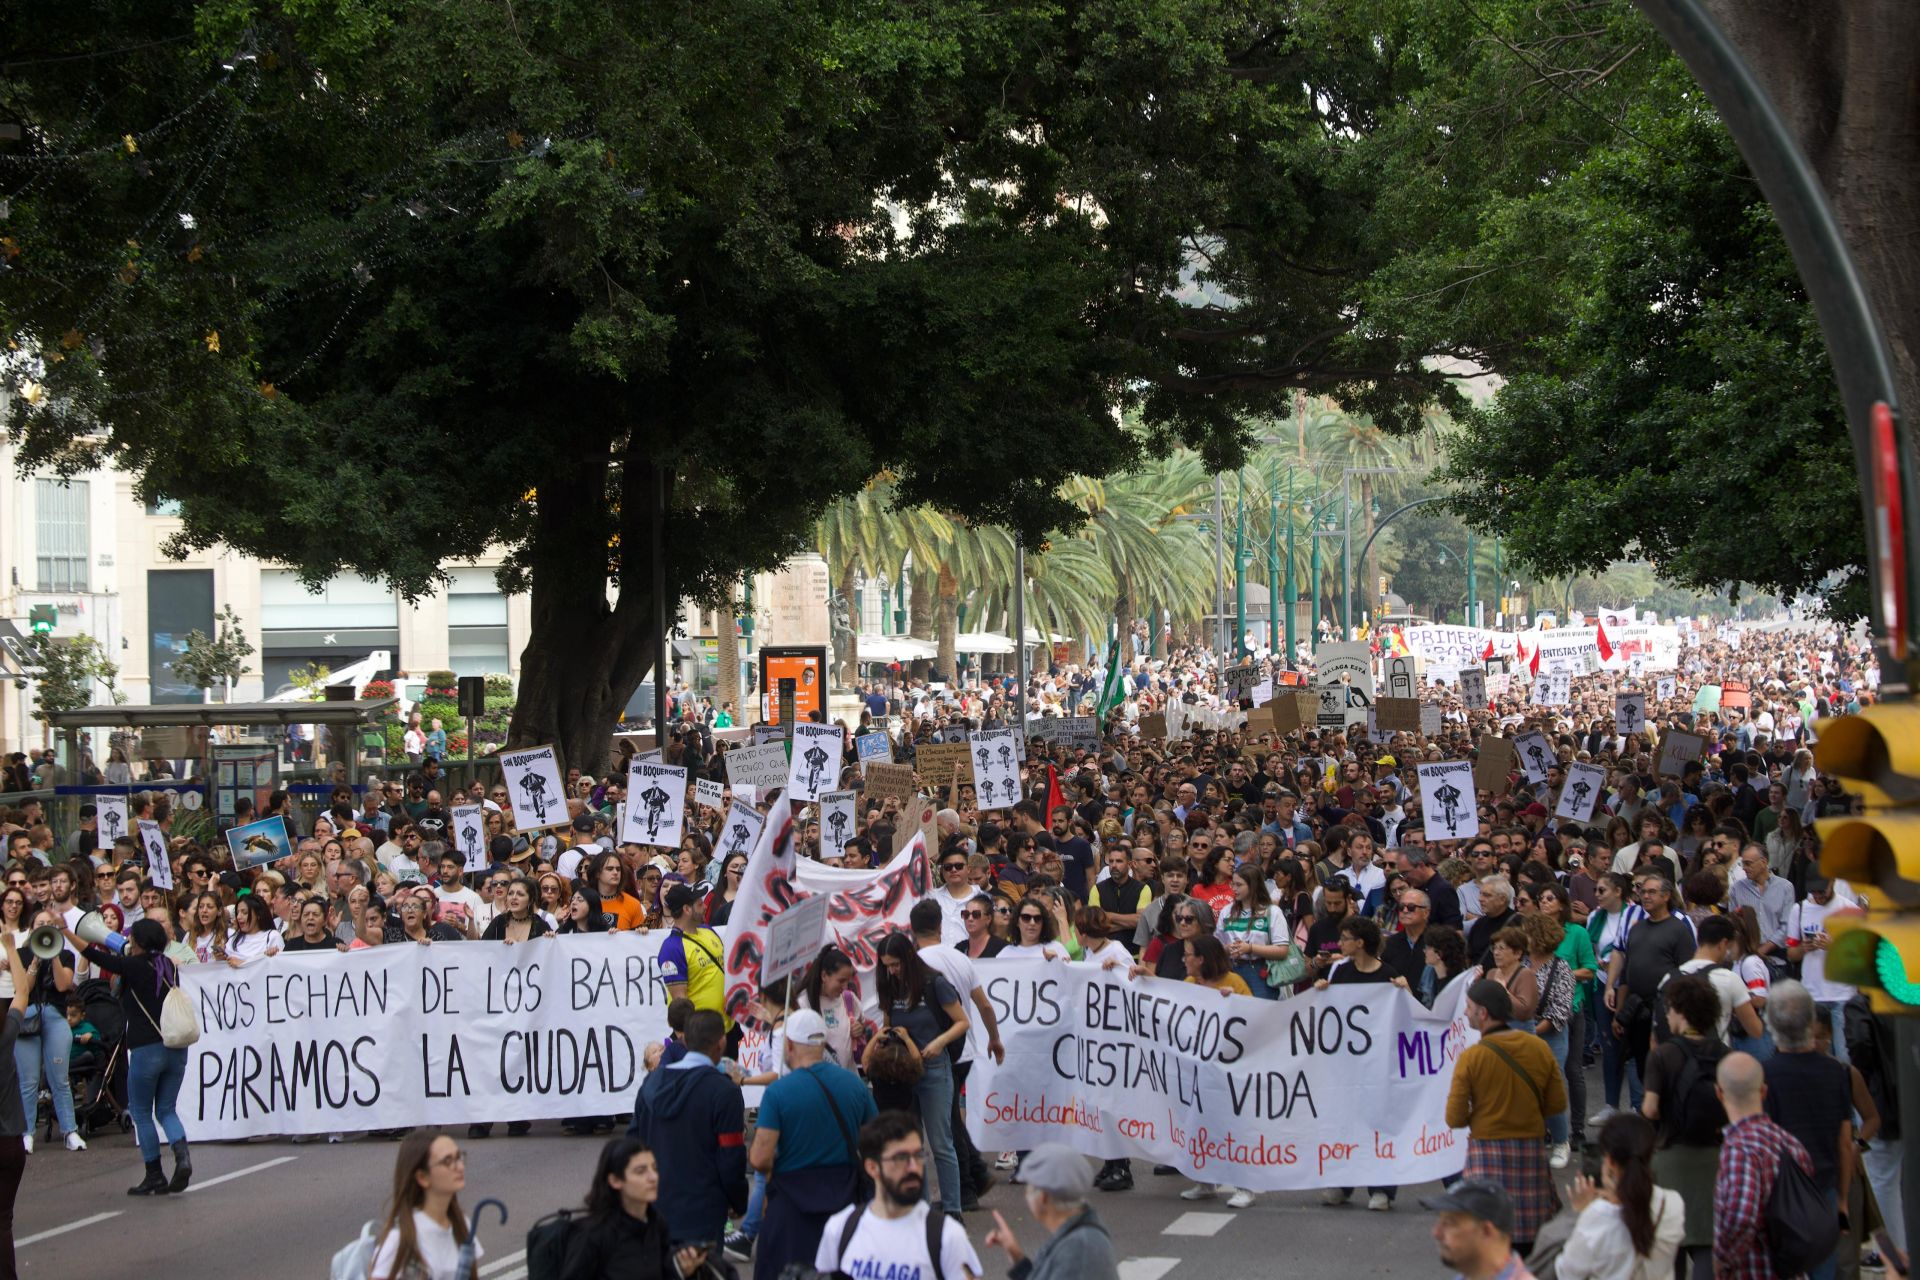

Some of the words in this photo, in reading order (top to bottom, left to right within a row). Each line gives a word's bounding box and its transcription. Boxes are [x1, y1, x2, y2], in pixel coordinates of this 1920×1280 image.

[806, 726, 840, 738] BOQUERONES
[980, 730, 1012, 741] BOQUERONES
[504, 757, 514, 767] SIN
[514, 749, 552, 767] BOQUERONES
[632, 766, 642, 774] SIN
[643, 764, 685, 779] BOQUERONES
[1430, 763, 1470, 777] BOQUERONES
[828, 794, 854, 805] BOQUERONES
[739, 805, 764, 824] BOQUERONES
[200, 982, 254, 1033] NOS
[267, 967, 388, 1024] ECHAN
[422, 966, 460, 1015] DE
[488, 964, 541, 1015] LOS
[572, 957, 668, 1010] BARR
[987, 977, 1061, 1026] SUS
[1086, 982, 1247, 1064] BENEFICIOS
[1290, 1004, 1373, 1056] NOS
[199, 1036, 380, 1120] PARAMOS
[424, 1033, 471, 1098] LA
[500, 1024, 635, 1096] CIUDAD
[1052, 1033, 1167, 1096] CUESTAN
[1178, 1064, 1203, 1115] LA
[1228, 1070, 1318, 1120] VIDA
[984, 1092, 1104, 1134] Solidaridad
[1118, 1116, 1156, 1142] con
[1170, 1110, 1186, 1148] las
[1189, 1127, 1298, 1170] afectadas
[1318, 1142, 1359, 1176] por
[1375, 1132, 1396, 1160] la
[1414, 1124, 1456, 1156] dana
[850, 1254, 920, 1280] MÁLAGA
